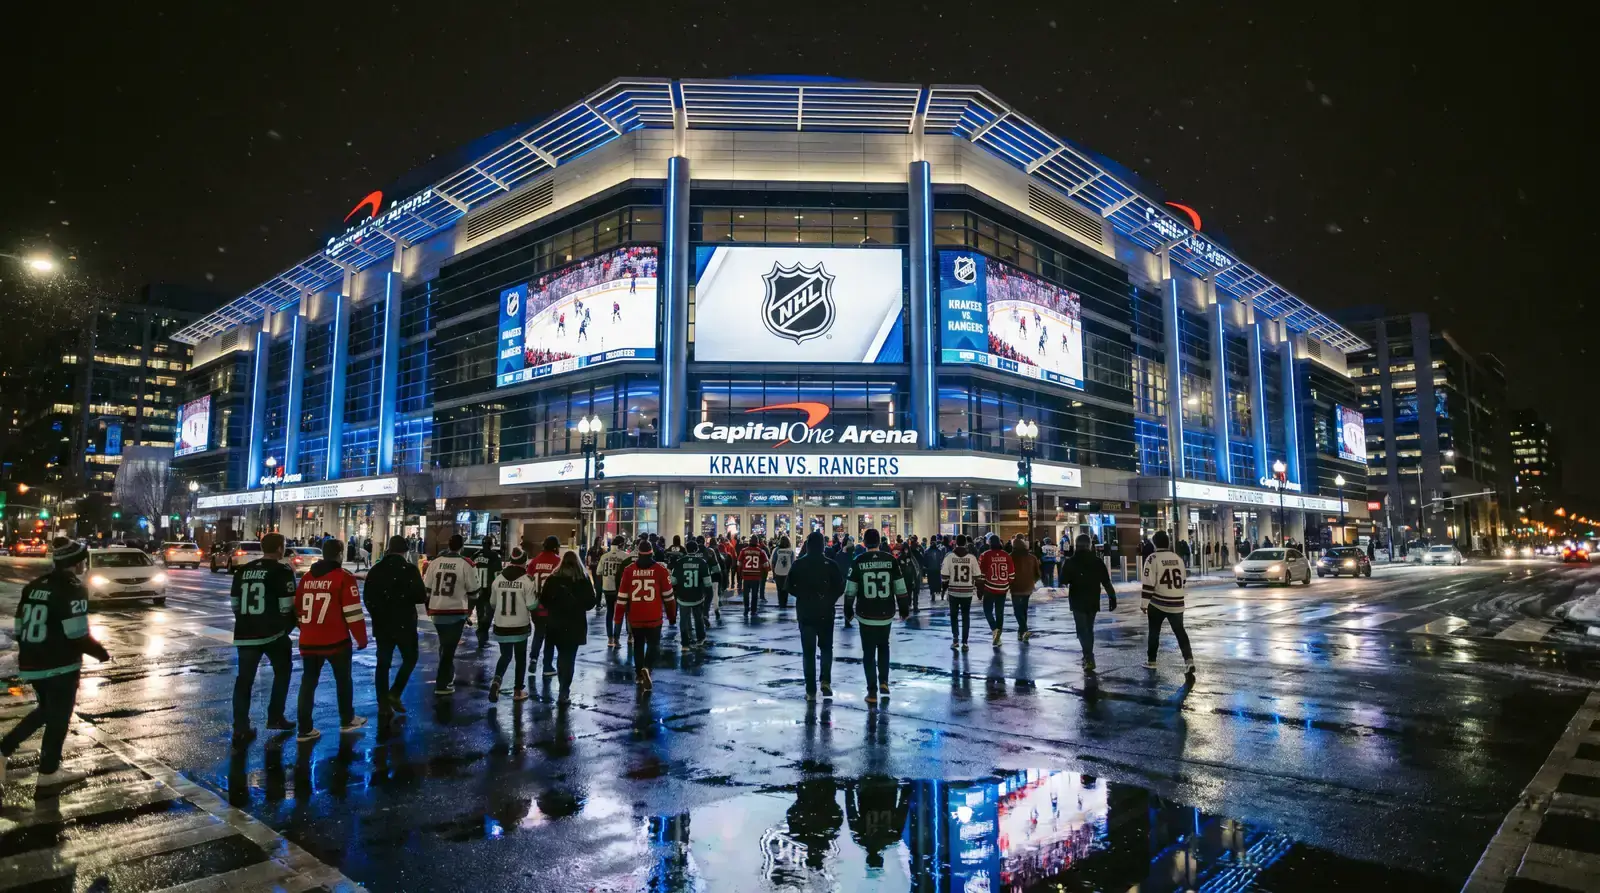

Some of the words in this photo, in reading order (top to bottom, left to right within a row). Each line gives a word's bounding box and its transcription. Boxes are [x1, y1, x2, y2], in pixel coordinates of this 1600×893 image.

[779, 283, 820, 325] NHL
[838, 427, 918, 444] Arena
[710, 456, 779, 474] KRAKEN
[785, 456, 812, 475] VS.
[819, 457, 899, 475] RANGERS
[745, 555, 760, 569] 29
[991, 563, 1008, 580] 16
[433, 571, 457, 597] 13
[683, 570, 699, 588] 31
[954, 565, 970, 582] 13
[1160, 568, 1183, 589] 46
[631, 579, 656, 602] 25
[863, 571, 891, 599] 63
[70, 599, 88, 614] 20
[240, 582, 266, 615] 13
[301, 592, 332, 624] 97
[500, 591, 517, 616] 11
